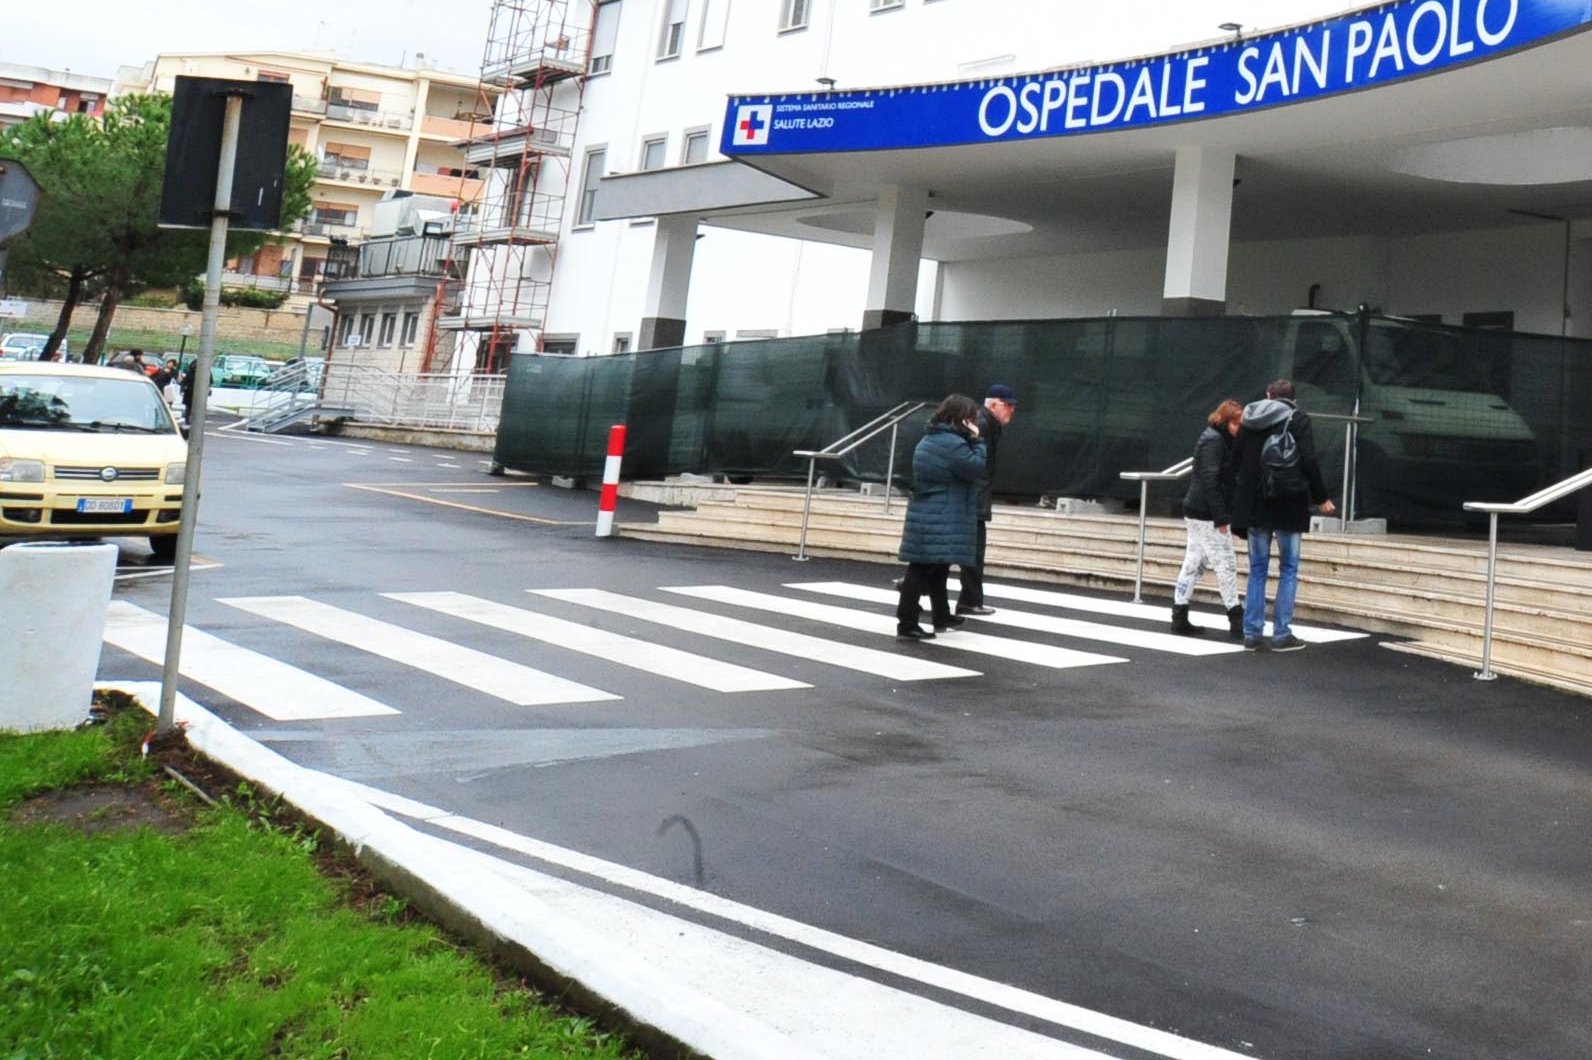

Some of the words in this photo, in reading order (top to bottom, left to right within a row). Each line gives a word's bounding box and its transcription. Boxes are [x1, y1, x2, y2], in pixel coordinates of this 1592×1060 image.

[977, 56, 1209, 137] OSPEDALE
[1234, 35, 1330, 105] SAN
[776, 104, 802, 113] SISTEMA
[802, 102, 836, 112] SANITARIO
[837, 100, 875, 110] REGIONALE
[773, 118, 806, 130] SALUTE
[806, 117, 834, 129] LAZIO
